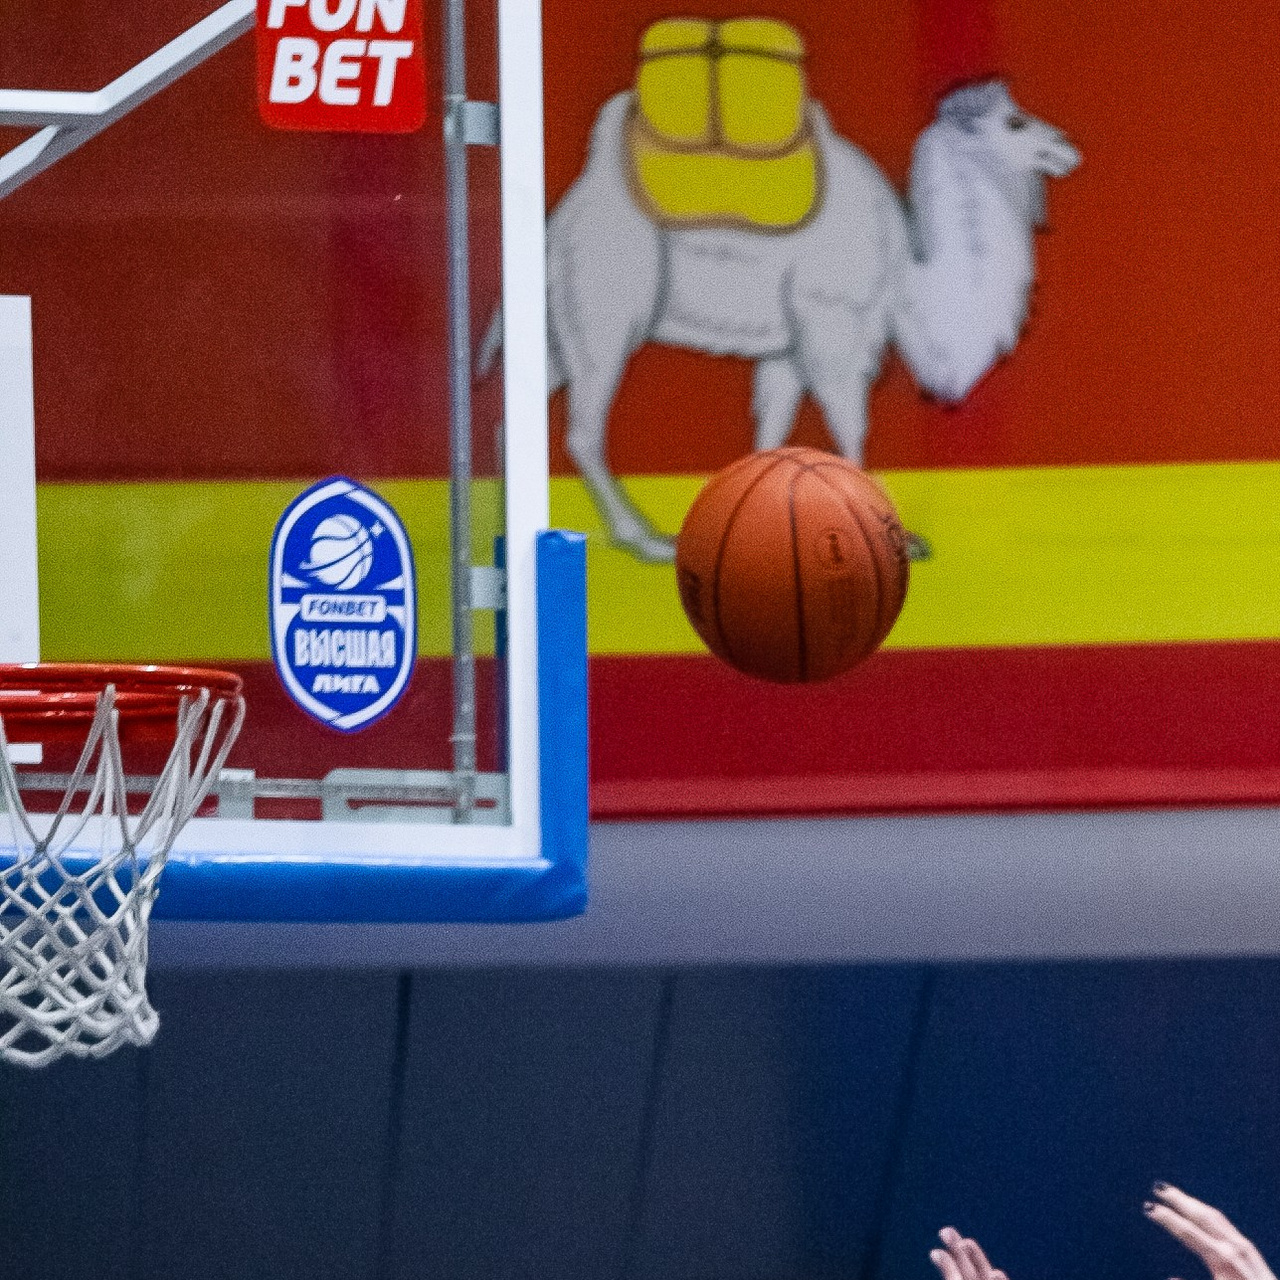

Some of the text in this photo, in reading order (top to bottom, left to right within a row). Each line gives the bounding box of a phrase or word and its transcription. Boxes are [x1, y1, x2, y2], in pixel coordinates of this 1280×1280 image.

[269, 37, 414, 106] BET
[308, 599, 378, 616] FONBET
[294, 628, 396, 668] ВЫСШАЯ
[312, 673, 380, 694] ЛИГА
